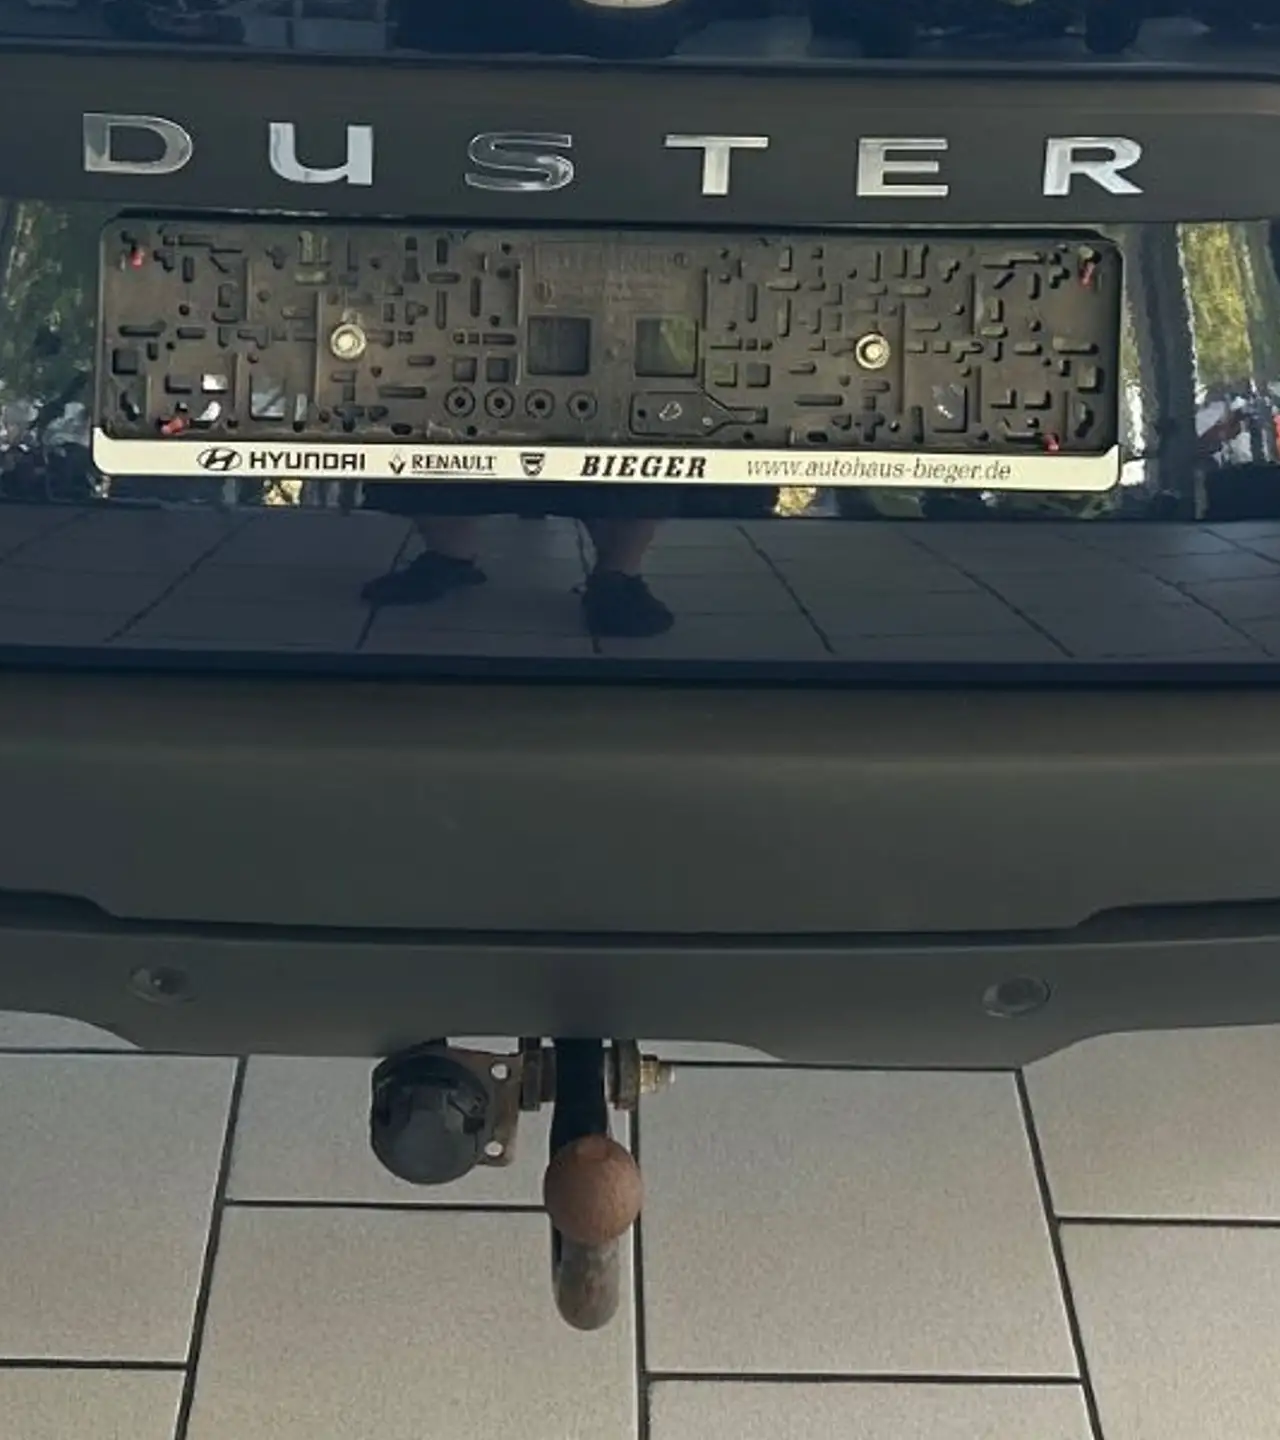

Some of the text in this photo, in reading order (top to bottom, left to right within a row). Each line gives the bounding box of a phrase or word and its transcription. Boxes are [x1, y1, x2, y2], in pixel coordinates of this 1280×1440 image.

[82, 112, 1143, 197] DUSTER
[249, 451, 1012, 481] HYUNDAI RENAULT BIEGER www.autohaus-bieger.de
